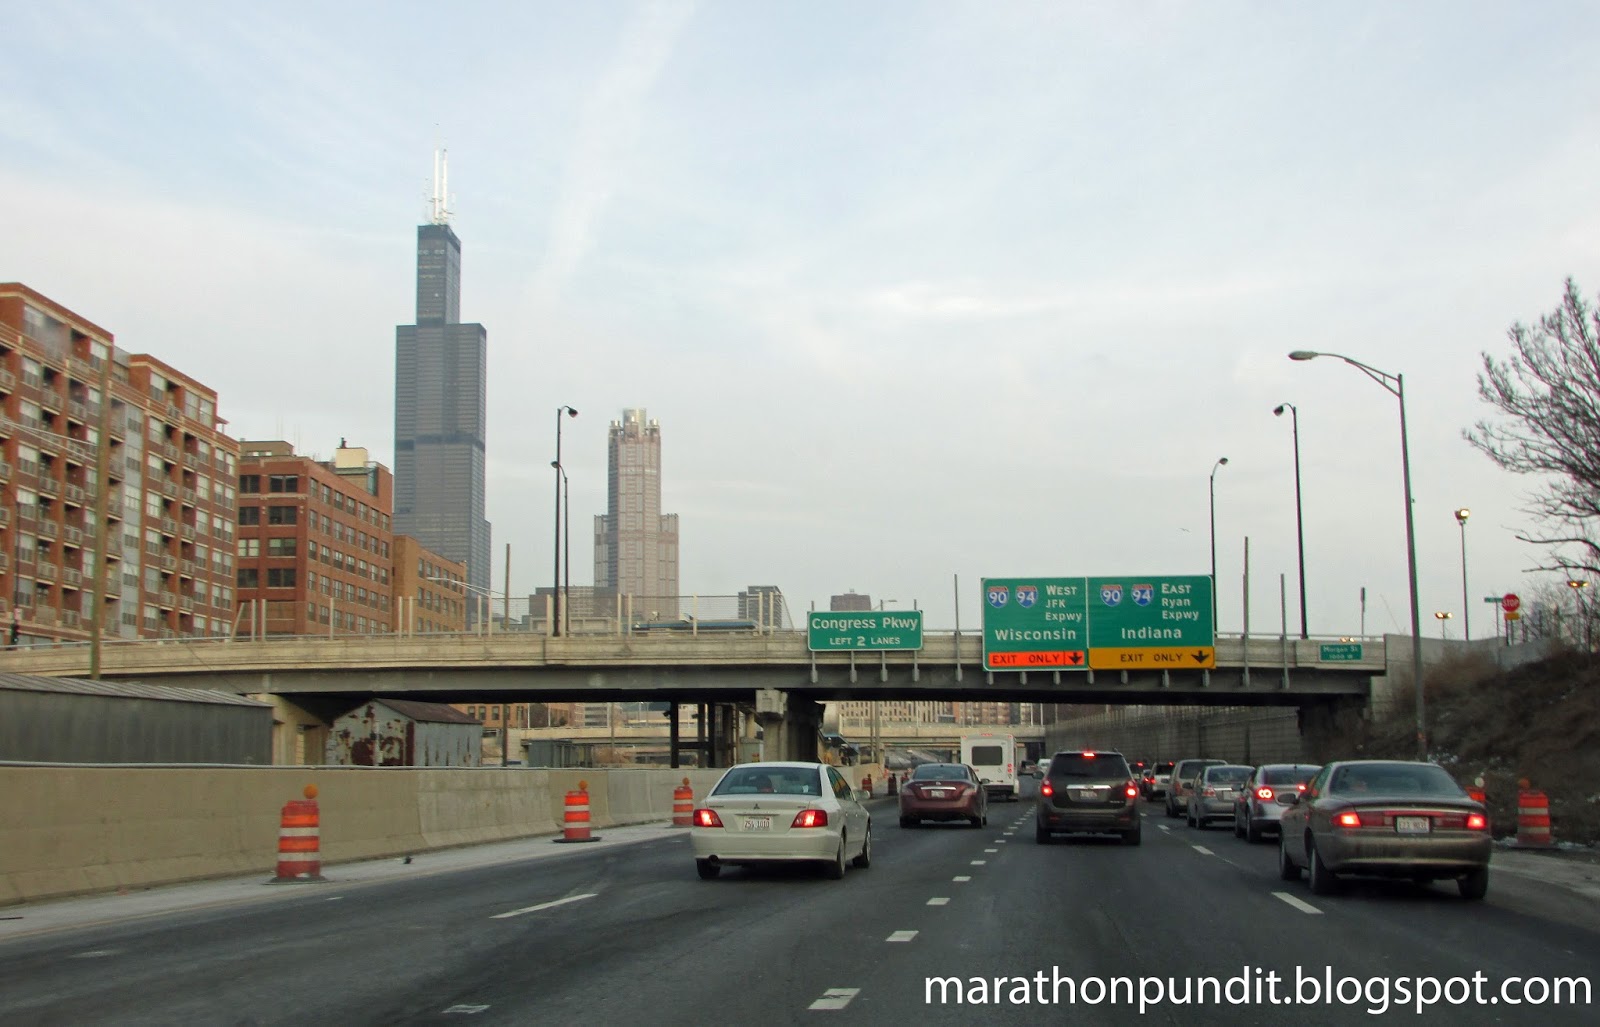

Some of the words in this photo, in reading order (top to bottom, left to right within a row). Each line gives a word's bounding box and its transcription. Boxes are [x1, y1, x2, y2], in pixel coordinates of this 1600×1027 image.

[1045, 585, 1077, 595] WEST
[1161, 583, 1191, 594] EAST
[989, 591, 1007, 604] 90
[1017, 591, 1035, 604] 94
[1102, 590, 1121, 602] 90
[1132, 589, 1151, 601] 94
[1045, 599, 1066, 608] JFK
[1162, 598, 1191, 608] Ryan
[1045, 612, 1082, 622] Expwy
[1162, 610, 1199, 620] Expwy
[811, 618, 877, 631] Congress
[882, 617, 918, 631] Pkwy
[994, 628, 1077, 640] Wisconsin
[1121, 627, 1182, 639] Indiana
[829, 637, 852, 645] LEFT
[857, 636, 866, 646] 2
[870, 636, 901, 645] LANES
[992, 654, 1017, 664] EXIT
[1028, 653, 1060, 663] ONLY
[1120, 653, 1144, 662] EXIT
[1153, 653, 1183, 662] ONLY
